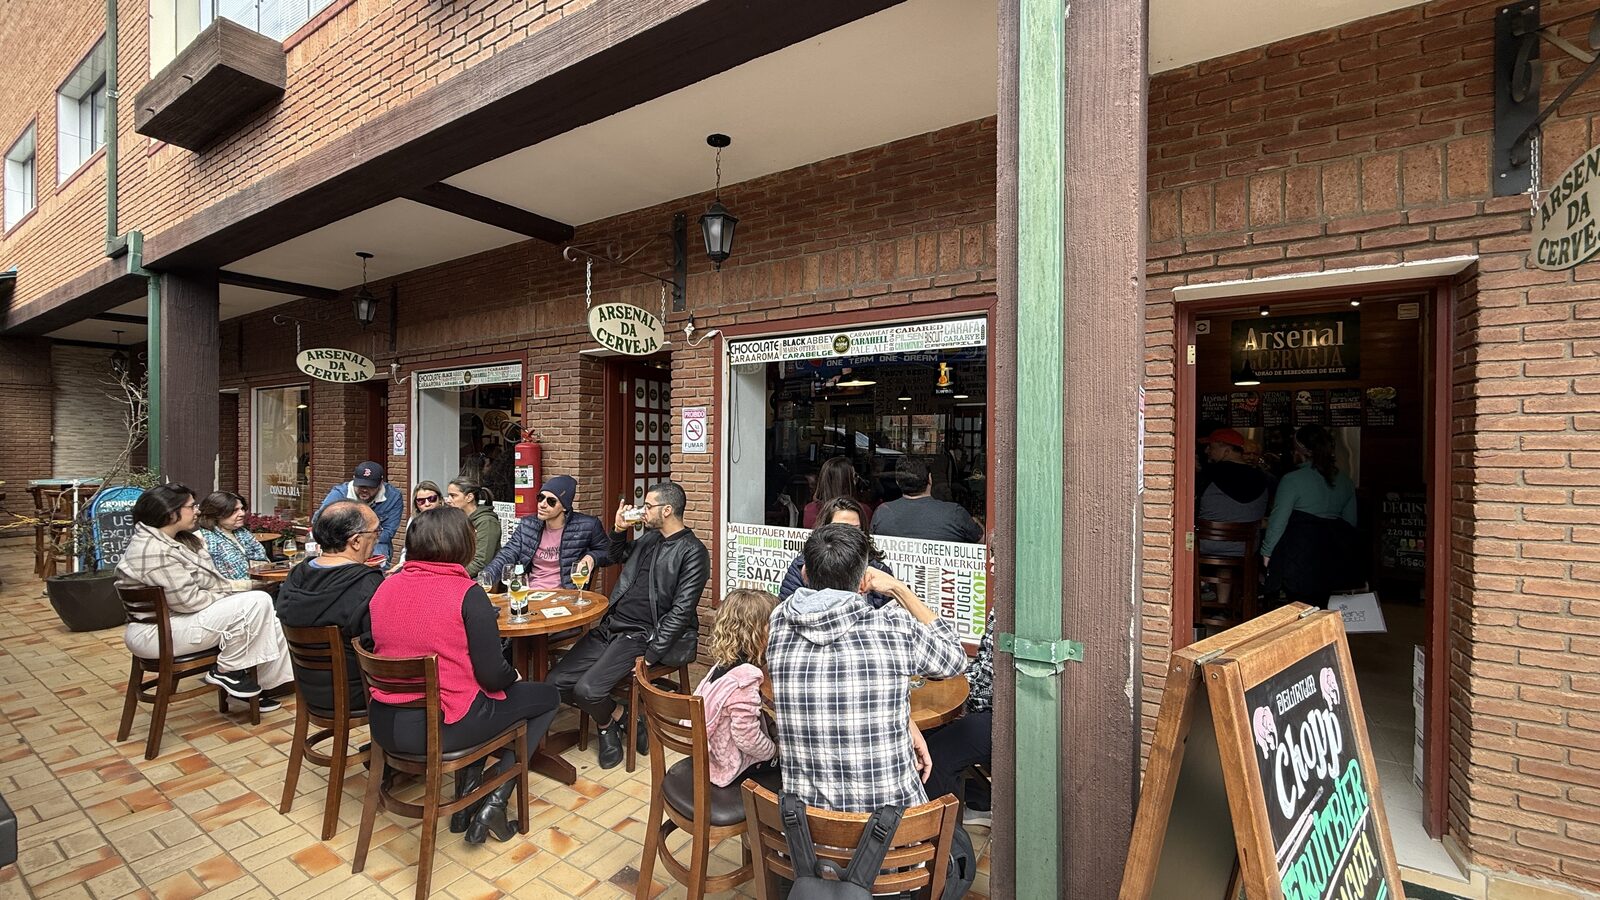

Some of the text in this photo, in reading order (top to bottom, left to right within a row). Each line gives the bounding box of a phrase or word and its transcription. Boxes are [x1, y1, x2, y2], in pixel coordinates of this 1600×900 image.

[1540, 147, 1600, 231] ARSEN
[1567, 191, 1591, 231] DA
[1537, 218, 1600, 266] CERVE
[598, 305, 657, 333] ARSENAL
[620, 321, 638, 337] DA
[849, 329, 889, 338] CARAWHEAT
[895, 324, 944, 334] CARARED
[944, 321, 980, 336] CARAFA
[1244, 321, 1345, 351] Arsenal
[596, 327, 658, 354] CERVEJA
[782, 337, 806, 347] BLACK
[807, 335, 835, 345] ABBEY
[850, 335, 889, 346] CARAHELL
[895, 332, 924, 342] PILSEN
[943, 333, 981, 343] CARARYE
[730, 340, 779, 355] CHOCOLATE
[782, 350, 833, 360] CARABELGE
[850, 345, 871, 355] PALE
[871, 343, 889, 353] ALE
[306, 350, 368, 368] ARSENAL
[329, 360, 347, 371] DA
[730, 352, 780, 364] CARAAROMA
[826, 354, 938, 367] ONE TEAM ONE DREAM
[1257, 346, 1344, 370] CERVEJA
[304, 364, 368, 382] CERVEJA
[727, 525, 785, 538] HALLERTAUER
[738, 535, 782, 549] MOUNT HOOD
[875, 537, 922, 554] TARGET
[922, 543, 951, 557] GREEN
[742, 546, 796, 560] AHTAN
[884, 551, 986, 571] ALLERTAUER MERKUR
[746, 566, 781, 584] SAAZ
[889, 562, 913, 583] ALT
[941, 568, 956, 619] GALAXY
[957, 569, 971, 621] FUGGLE
[1276, 674, 1317, 715] DELIRIUM
[1275, 708, 1342, 820] Chopp
[1281, 758, 1368, 900] FRUITBIER
